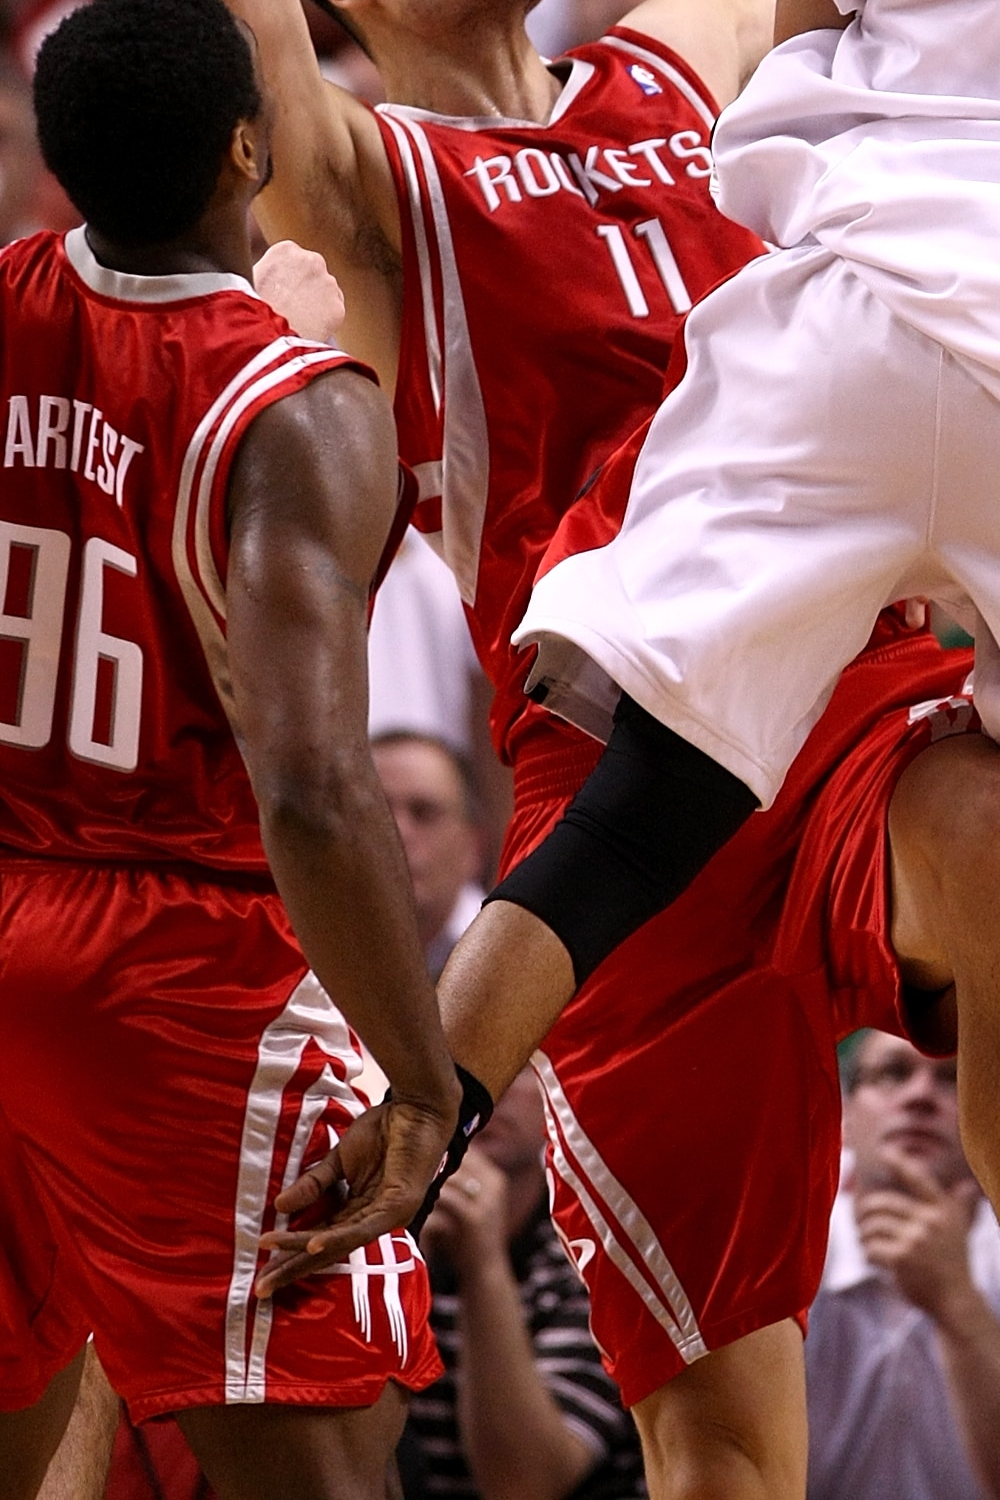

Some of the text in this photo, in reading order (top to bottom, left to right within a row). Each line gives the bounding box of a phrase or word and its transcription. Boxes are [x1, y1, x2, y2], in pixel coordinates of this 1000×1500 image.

[462, 130, 714, 212] ROCKETS
[597, 216, 693, 318] 11
[3, 395, 145, 508] ARTEST
[0, 519, 144, 774] 96
